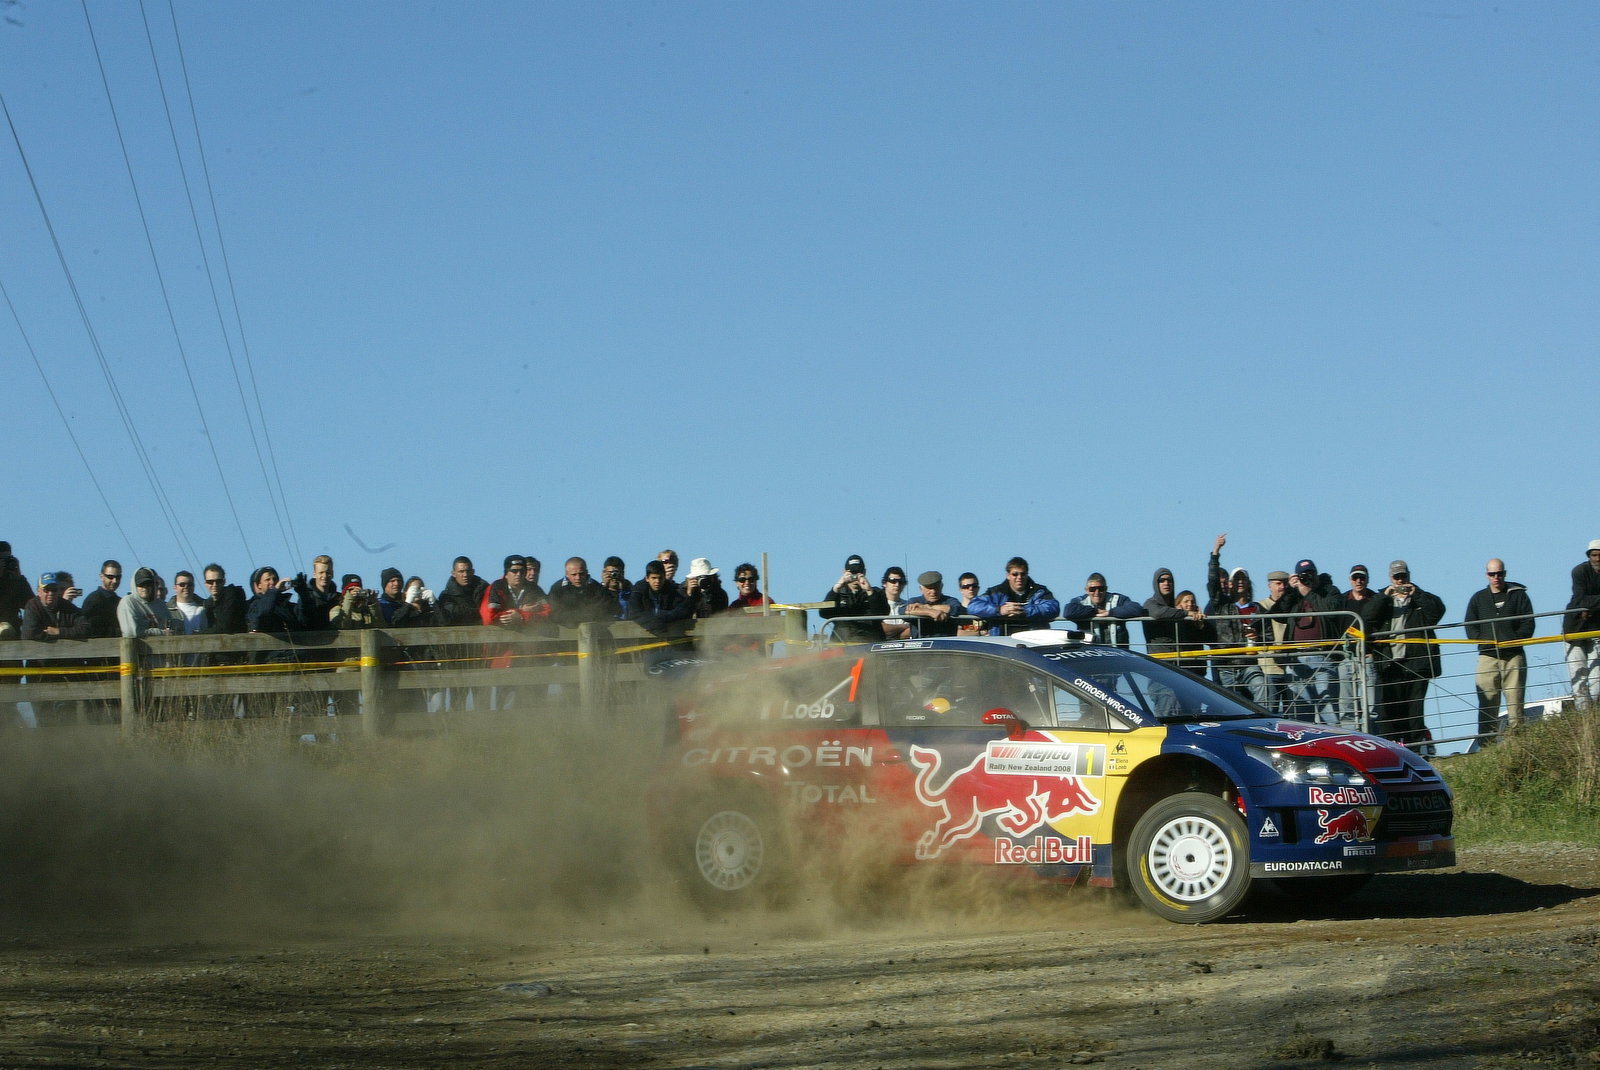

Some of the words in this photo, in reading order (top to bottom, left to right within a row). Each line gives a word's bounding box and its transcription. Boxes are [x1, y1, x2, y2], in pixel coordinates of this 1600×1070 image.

[848, 657, 865, 703] 1
[782, 699, 835, 719] Loeb
[1074, 678, 1143, 725] CITROEN-WRC.COM
[681, 740, 873, 768] CITROËN
[1085, 746, 1095, 775] 1
[988, 763, 1006, 771] Rally
[1024, 764, 1052, 772] Zealand
[1053, 765, 1071, 773] 2008
[783, 781, 876, 804] TOTAL
[1308, 787, 1345, 806] Red
[1345, 786, 1378, 805] Bull
[995, 835, 1043, 864] Red
[1044, 835, 1093, 864] Bull
[1343, 845, 1376, 857] PIRELLI
[1264, 860, 1343, 872] EURODATACAR
